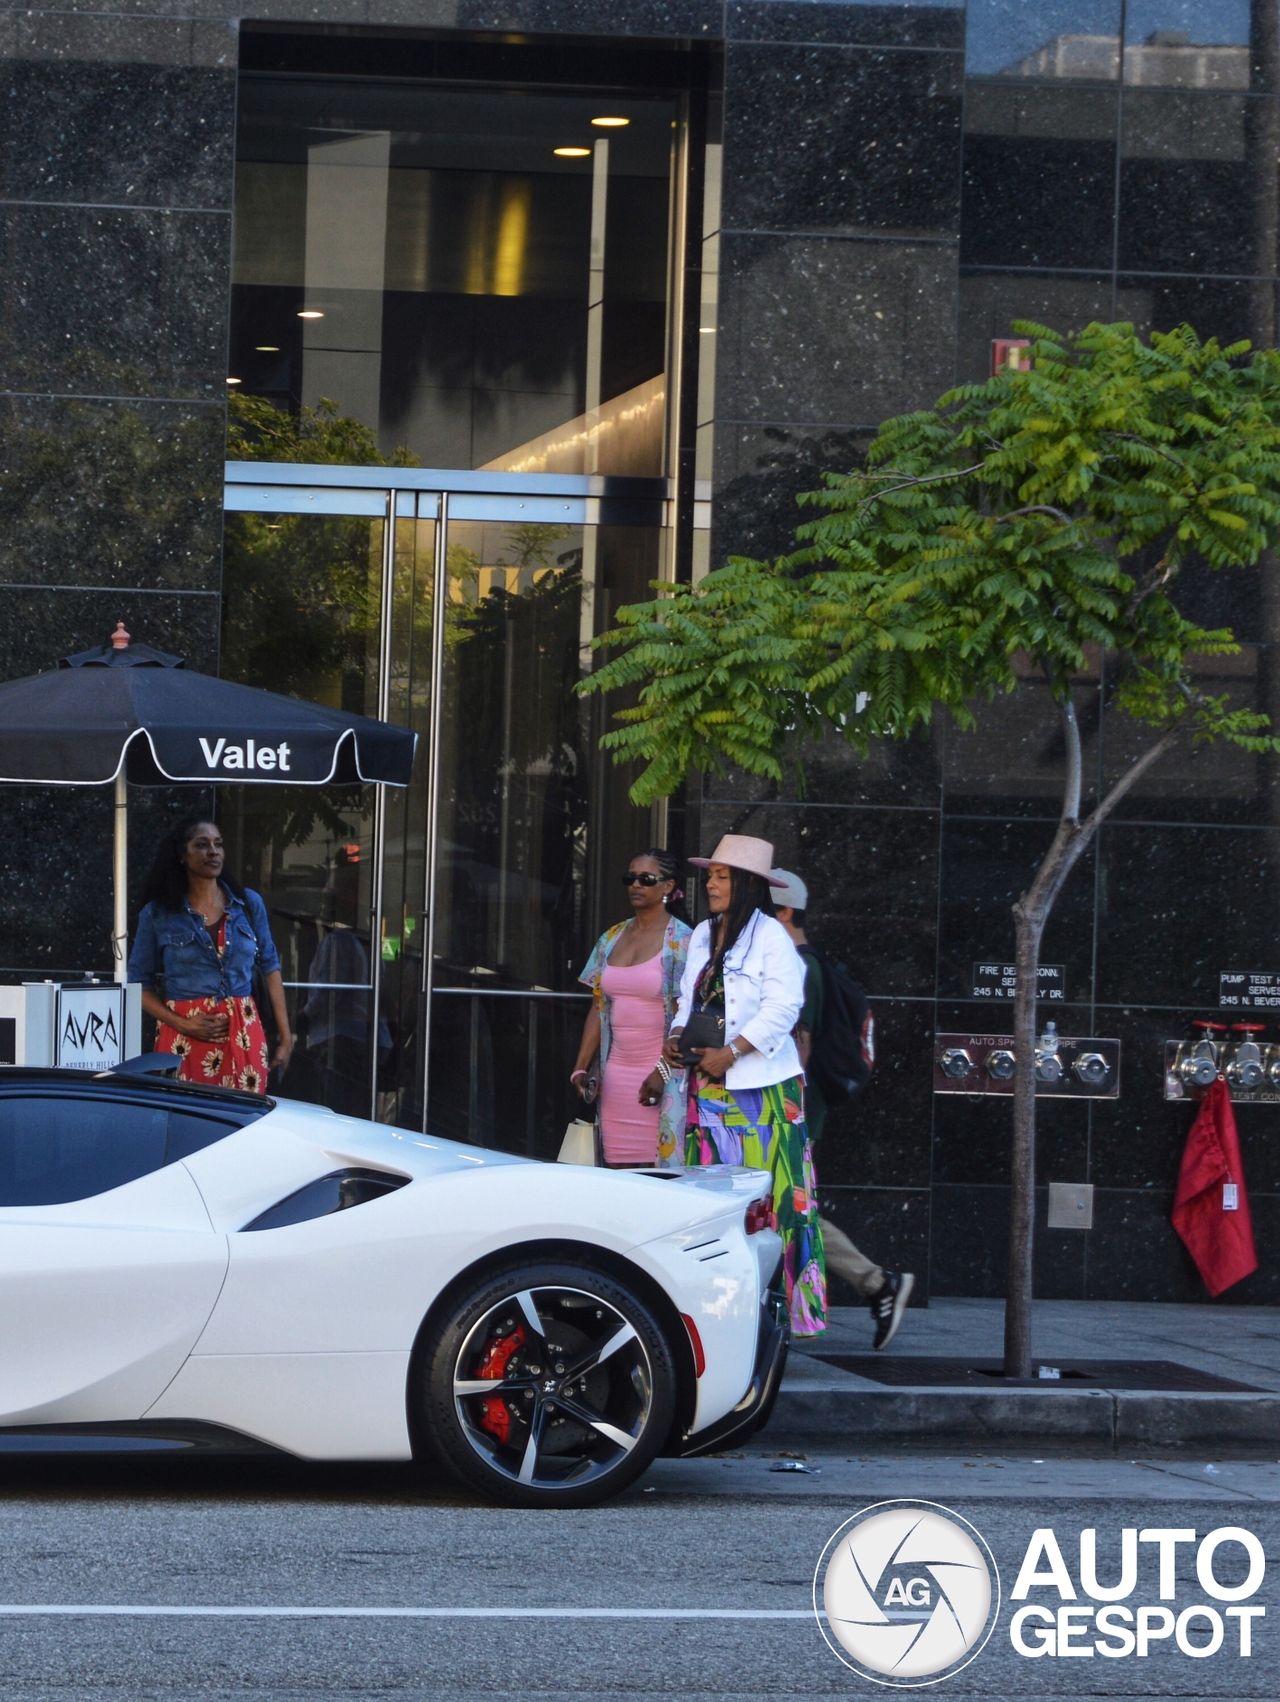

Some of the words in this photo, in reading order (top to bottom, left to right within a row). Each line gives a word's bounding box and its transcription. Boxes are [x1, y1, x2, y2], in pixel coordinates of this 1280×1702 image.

[199, 738, 291, 771] Valet
[979, 966, 999, 975] FIRE
[1221, 974, 1245, 983] PUMP
[1249, 975, 1273, 984] TEST
[973, 987, 991, 996] 245
[995, 989, 1003, 997] N.
[1049, 990, 1065, 999] DR.
[1220, 995, 1239, 1005] 245
[1241, 996, 1251, 1005] N.
[61, 1006, 119, 1052] AVRA
[1232, 1091, 1256, 1101] TEST
